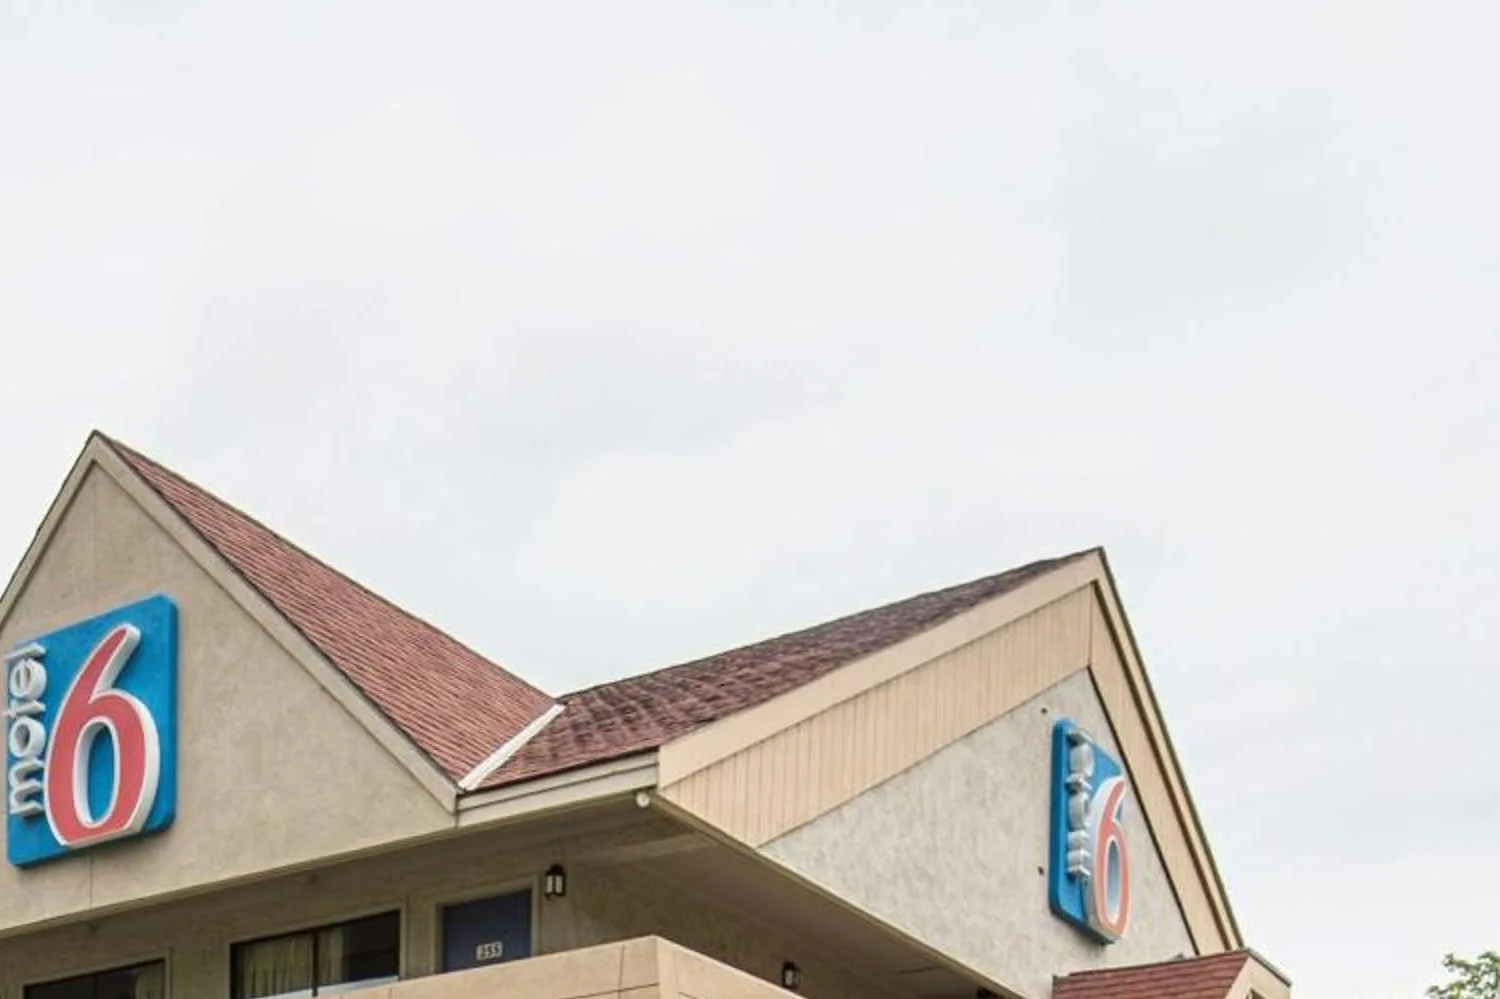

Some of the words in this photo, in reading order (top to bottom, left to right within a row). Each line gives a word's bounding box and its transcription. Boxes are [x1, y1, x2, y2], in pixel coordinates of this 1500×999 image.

[2, 642, 46, 816] motel
[44, 623, 160, 847] 6
[1086, 773, 1130, 939] 6
